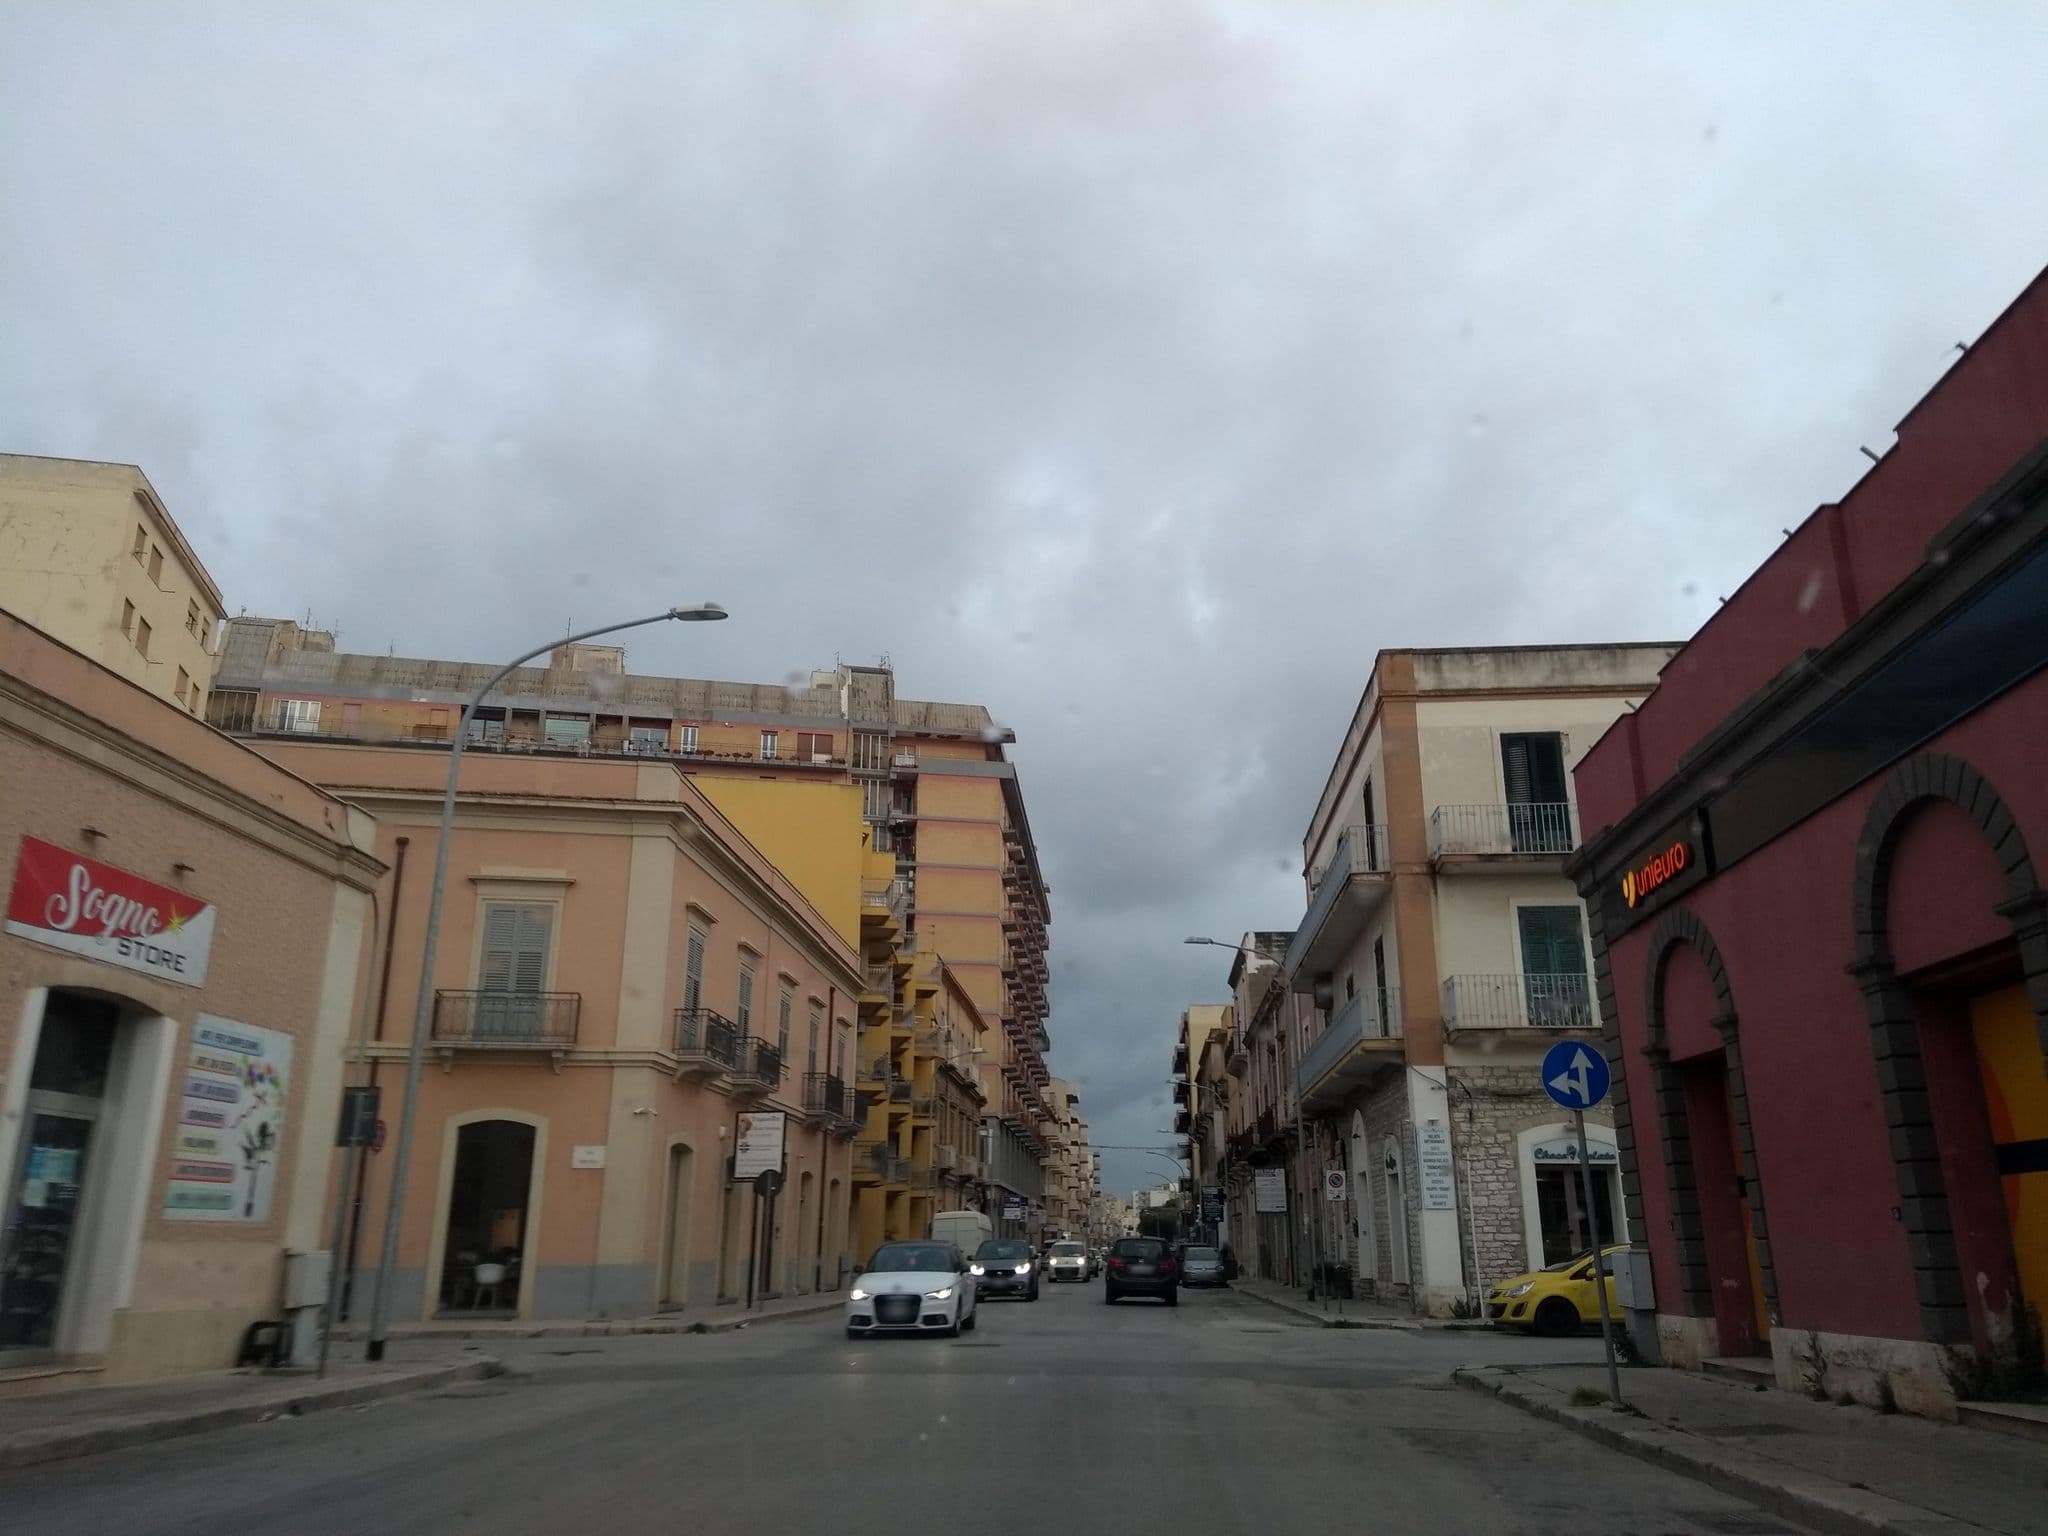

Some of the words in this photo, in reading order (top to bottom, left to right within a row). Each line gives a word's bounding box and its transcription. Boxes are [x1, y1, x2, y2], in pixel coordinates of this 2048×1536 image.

[1635, 842, 1687, 897] unieuro
[44, 863, 163, 945] Sogno
[117, 936, 188, 974] STORE
